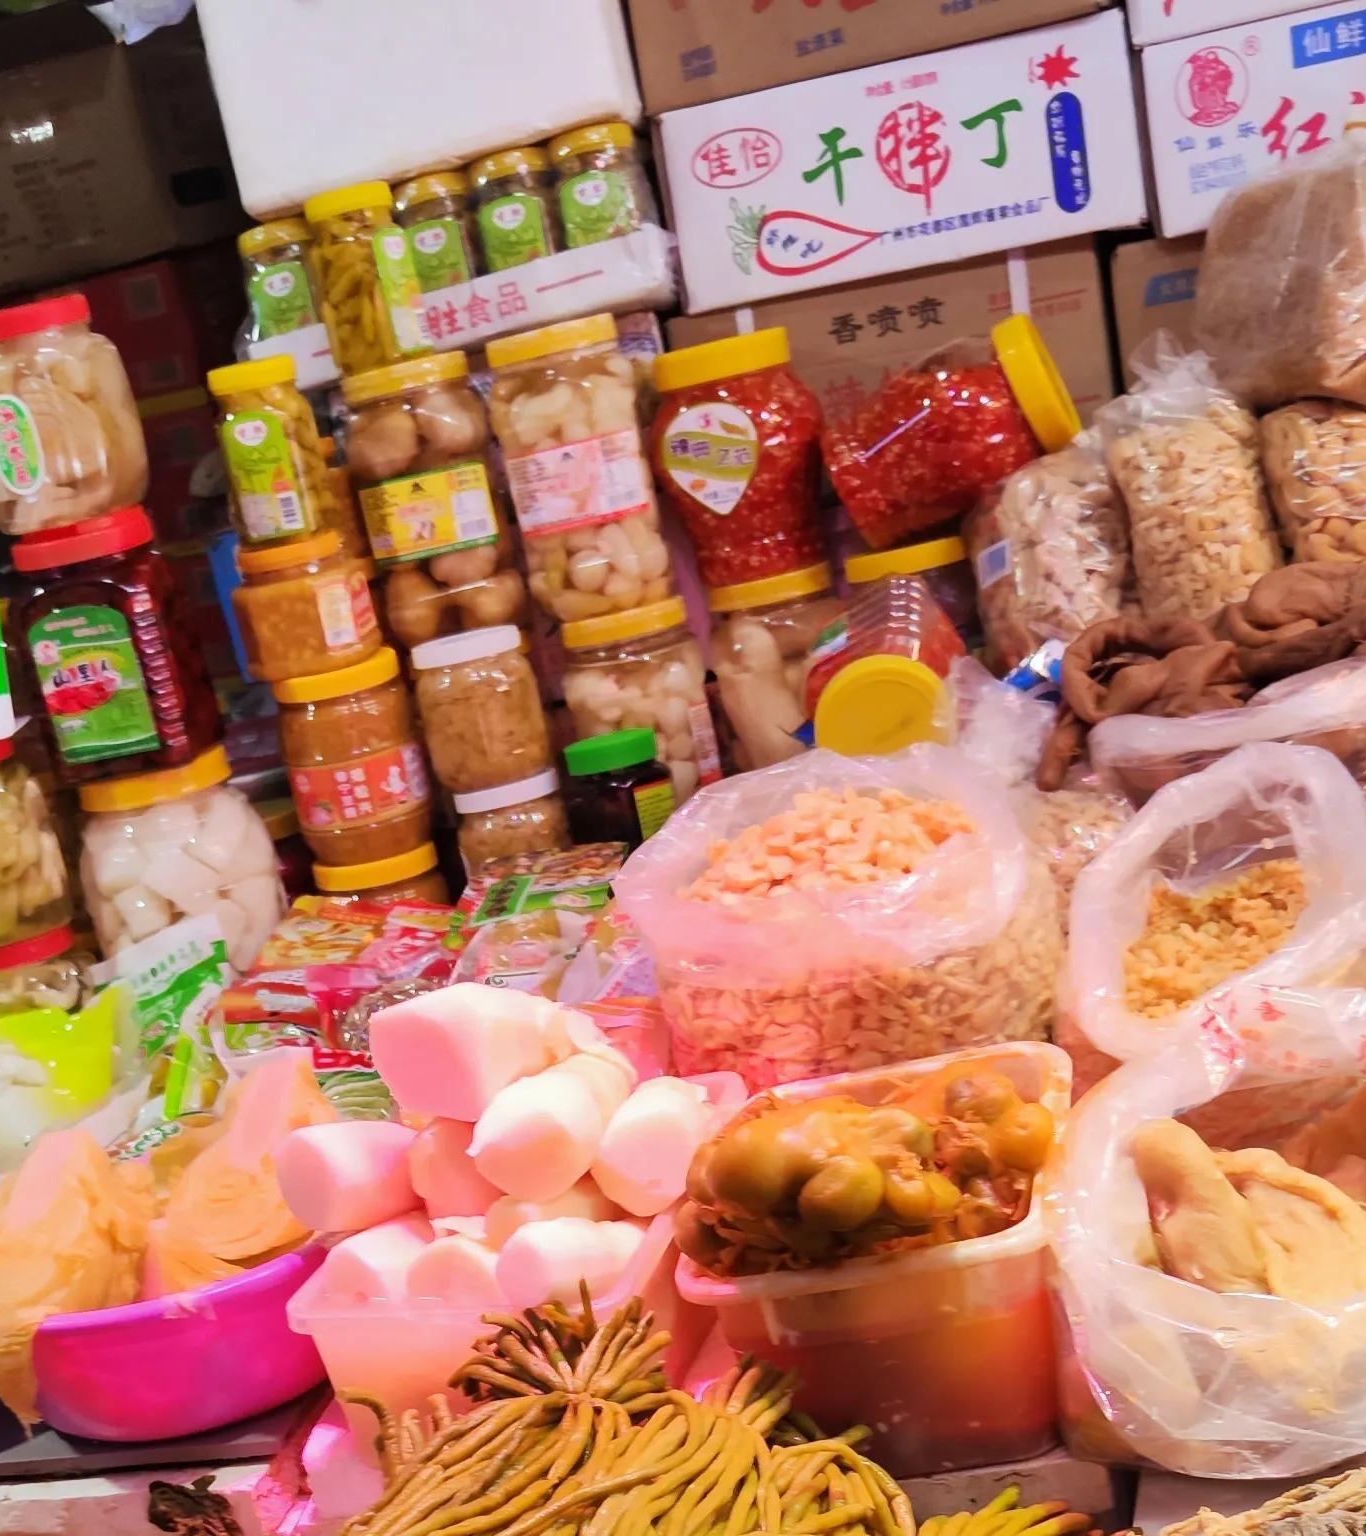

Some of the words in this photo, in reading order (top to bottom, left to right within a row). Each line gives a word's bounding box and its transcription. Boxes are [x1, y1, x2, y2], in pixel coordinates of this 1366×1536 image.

[700, 135, 771, 183] 佳怡
[828, 296, 945, 346] 香喷喷
